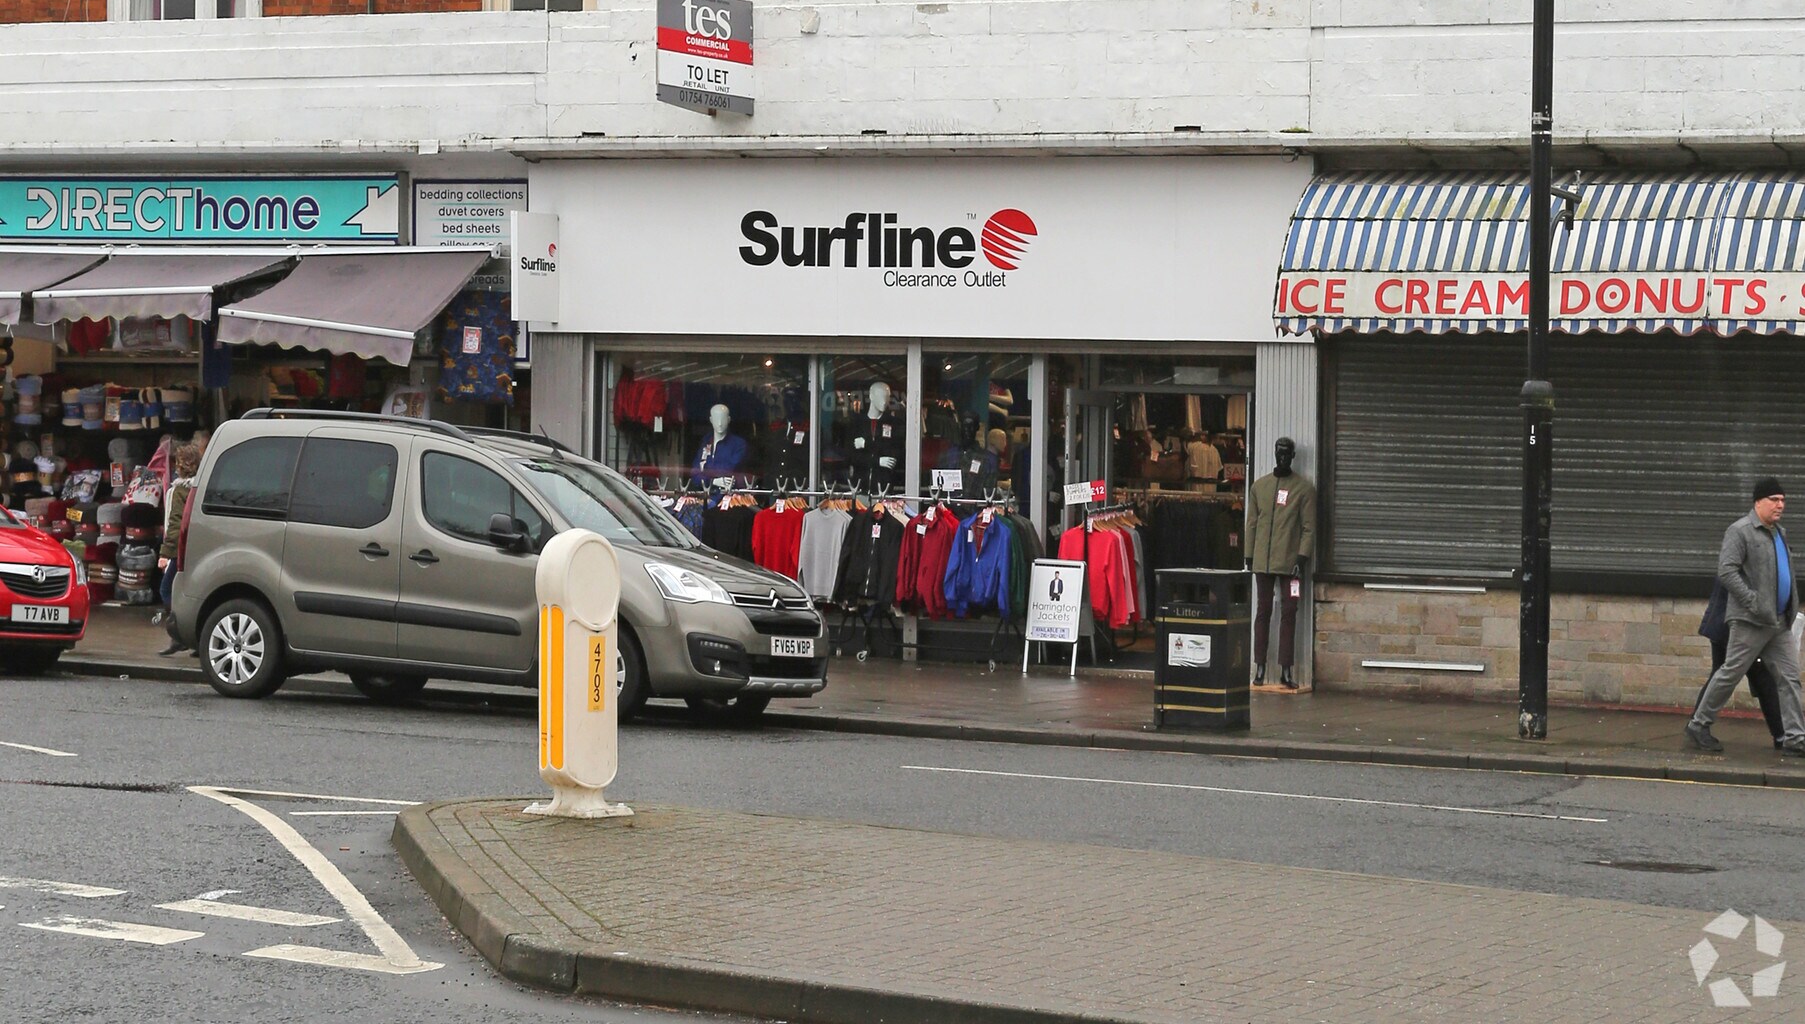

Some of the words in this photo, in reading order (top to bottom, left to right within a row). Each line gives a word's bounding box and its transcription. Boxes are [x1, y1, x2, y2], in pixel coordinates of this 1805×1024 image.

[685, 36, 730, 51] COMMERCIAL
[687, 64, 703, 81] TO
[707, 68, 729, 85] LET
[682, 80, 707, 90] RETAIL
[714, 85, 730, 93] UNIT
[679, 90, 702, 104] 01754
[704, 94, 731, 108] 766061
[420, 189, 463, 202] bedding
[466, 189, 524, 200] collections
[438, 206, 468, 217] duvet
[470, 207, 505, 217] covers
[442, 223, 463, 233] bed
[466, 223, 501, 234] sheets
[739, 210, 976, 269] Surfline
[520, 256, 556, 273] Surfline
[883, 270, 957, 287] Clearance
[963, 270, 1007, 287] Outlet
[1278, 278, 1347, 314] ICE
[1374, 278, 1530, 315] CREAM
[1559, 278, 1768, 315] DONUTS
[1225, 466, 1245, 477] SAL
[1091, 486, 1105, 496] £12
[24, 606, 38, 620] T7
[40, 607, 60, 621] AVB
[1032, 601, 1077, 614] Harrington
[1037, 611, 1070, 622] Jackets
[774, 639, 796, 654] FV65
[592, 642, 601, 703] 4703
